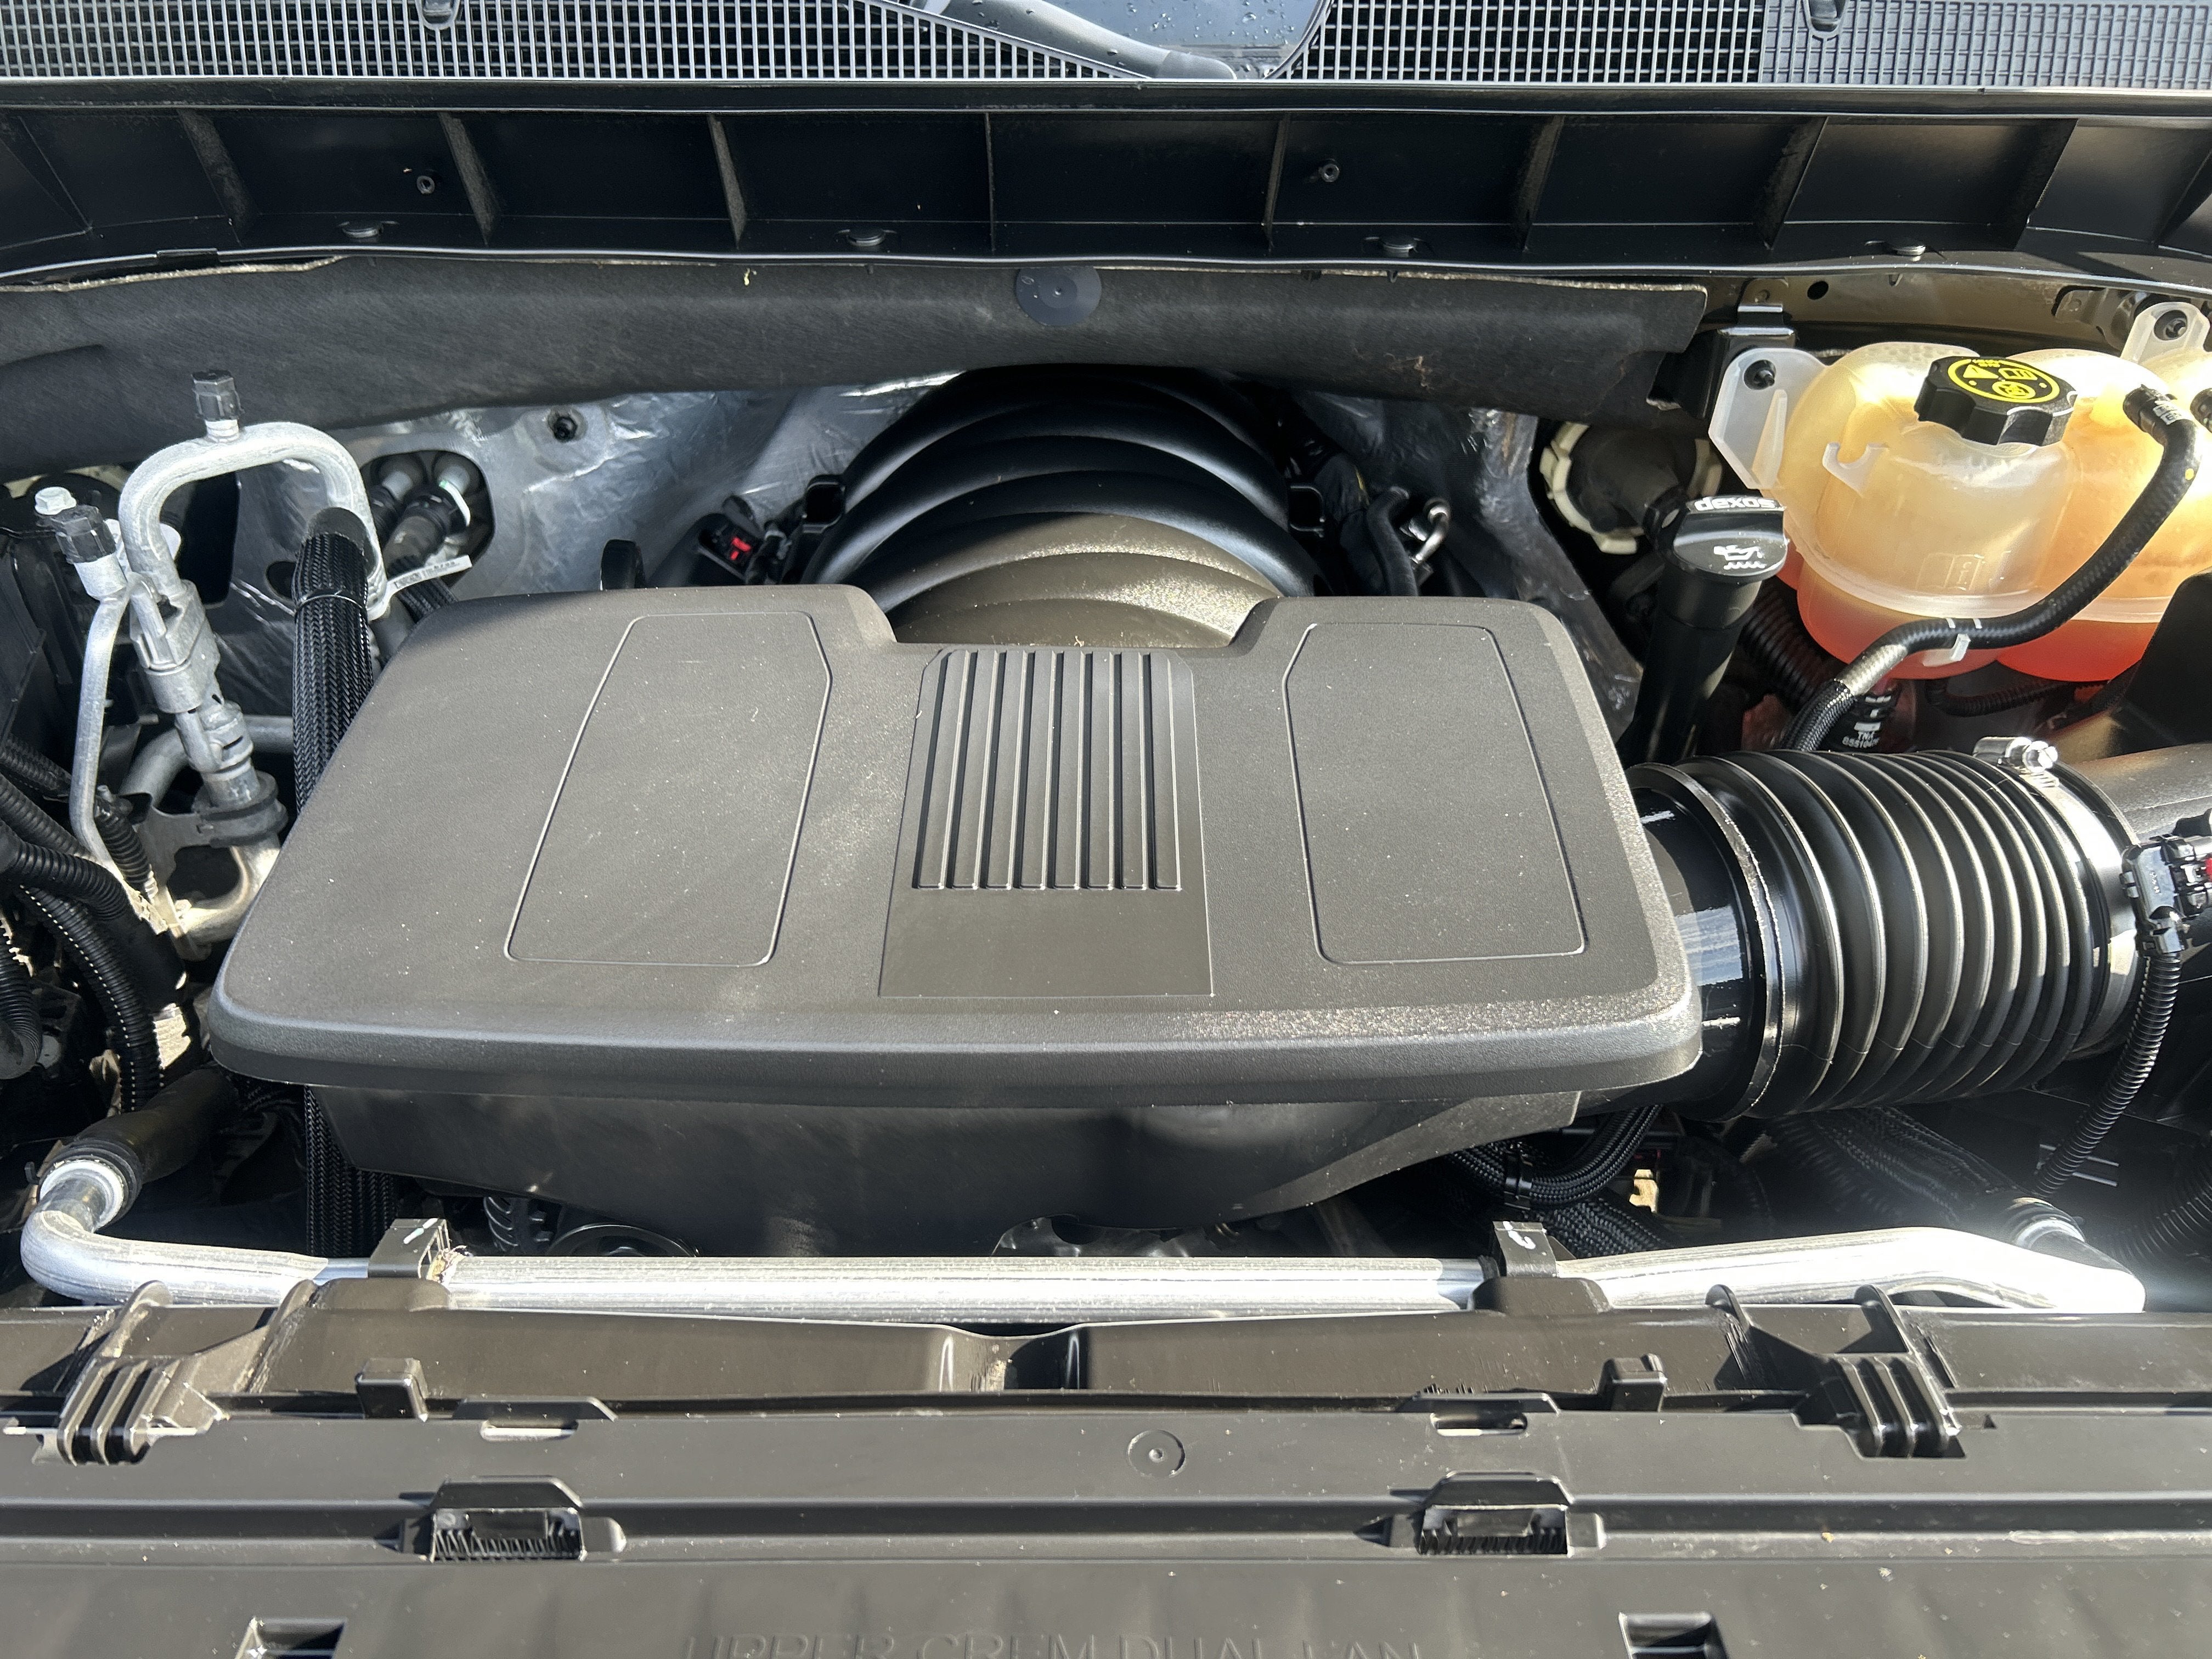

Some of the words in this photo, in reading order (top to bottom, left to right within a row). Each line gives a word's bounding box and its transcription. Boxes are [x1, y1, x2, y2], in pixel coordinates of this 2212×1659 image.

[1694, 496, 1776, 511] dexos
[687, 1633, 895, 1659] UPPER
[1119, 1635, 1262, 1659] DUAL
